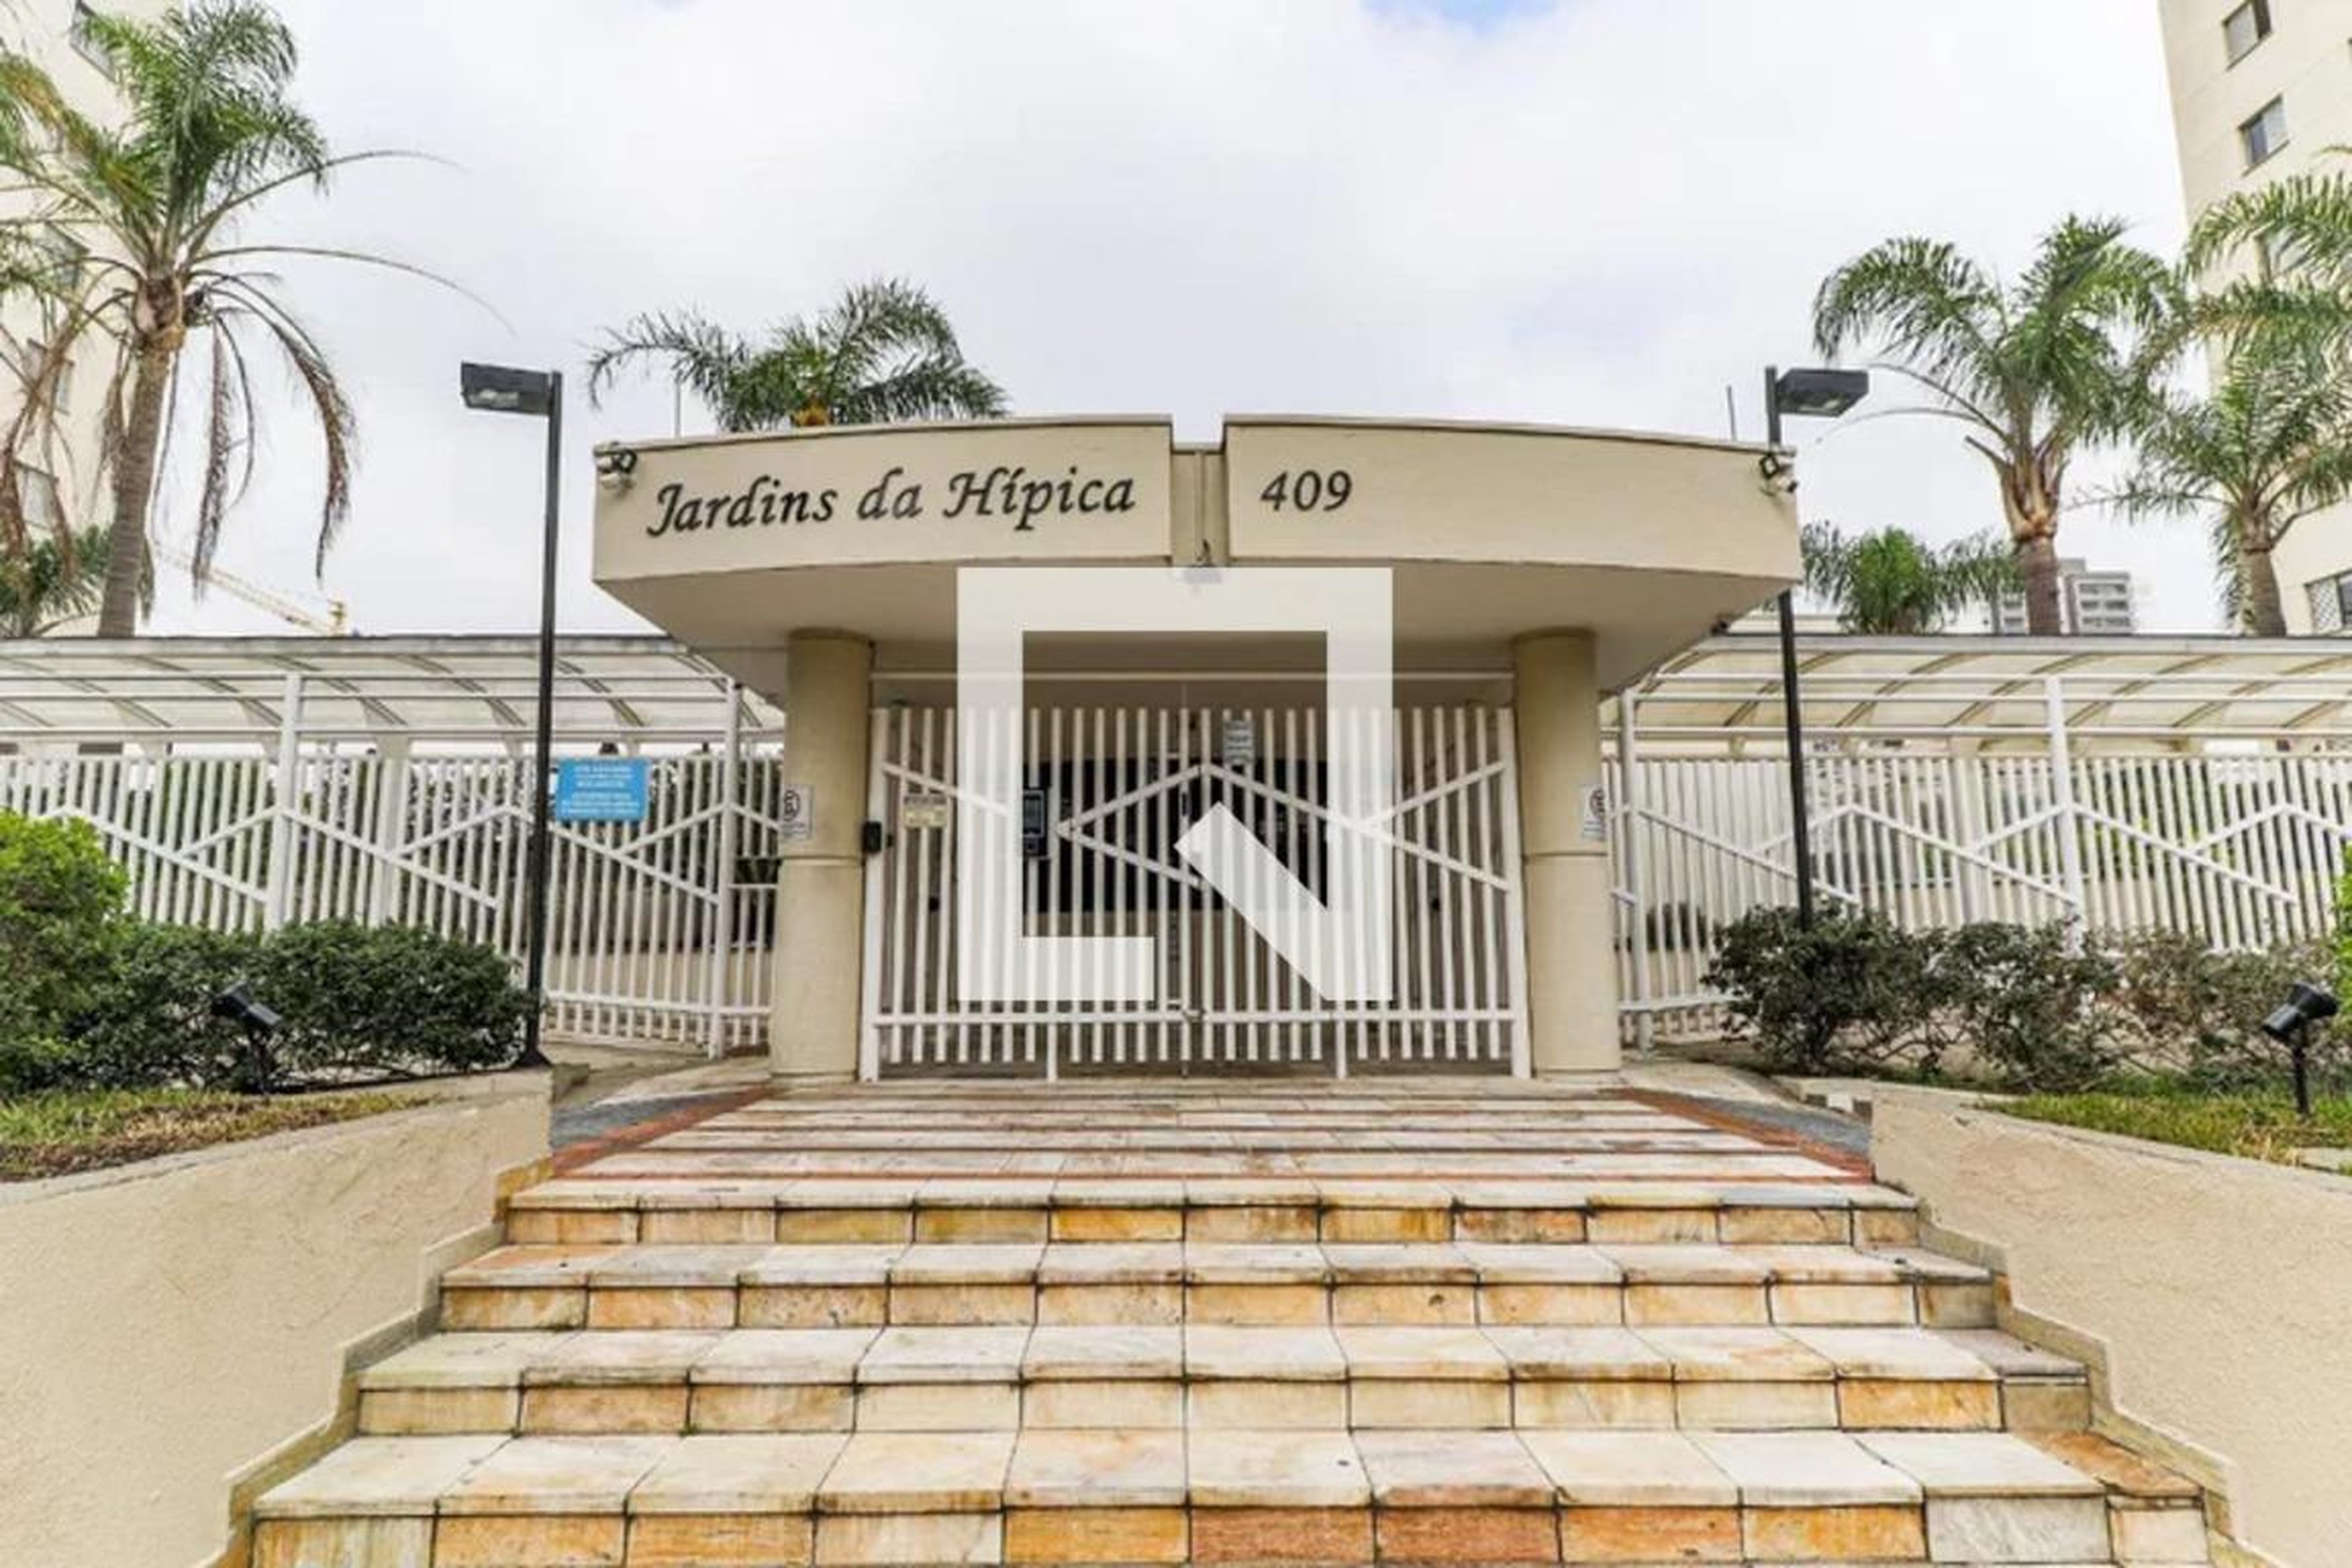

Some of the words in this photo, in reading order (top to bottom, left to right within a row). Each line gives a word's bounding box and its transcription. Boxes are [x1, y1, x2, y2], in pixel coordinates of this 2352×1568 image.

[646, 474, 839, 538] Jardins
[856, 467, 923, 521] da
[942, 466, 1136, 532] Hípica
[1260, 469, 1352, 512] 409
